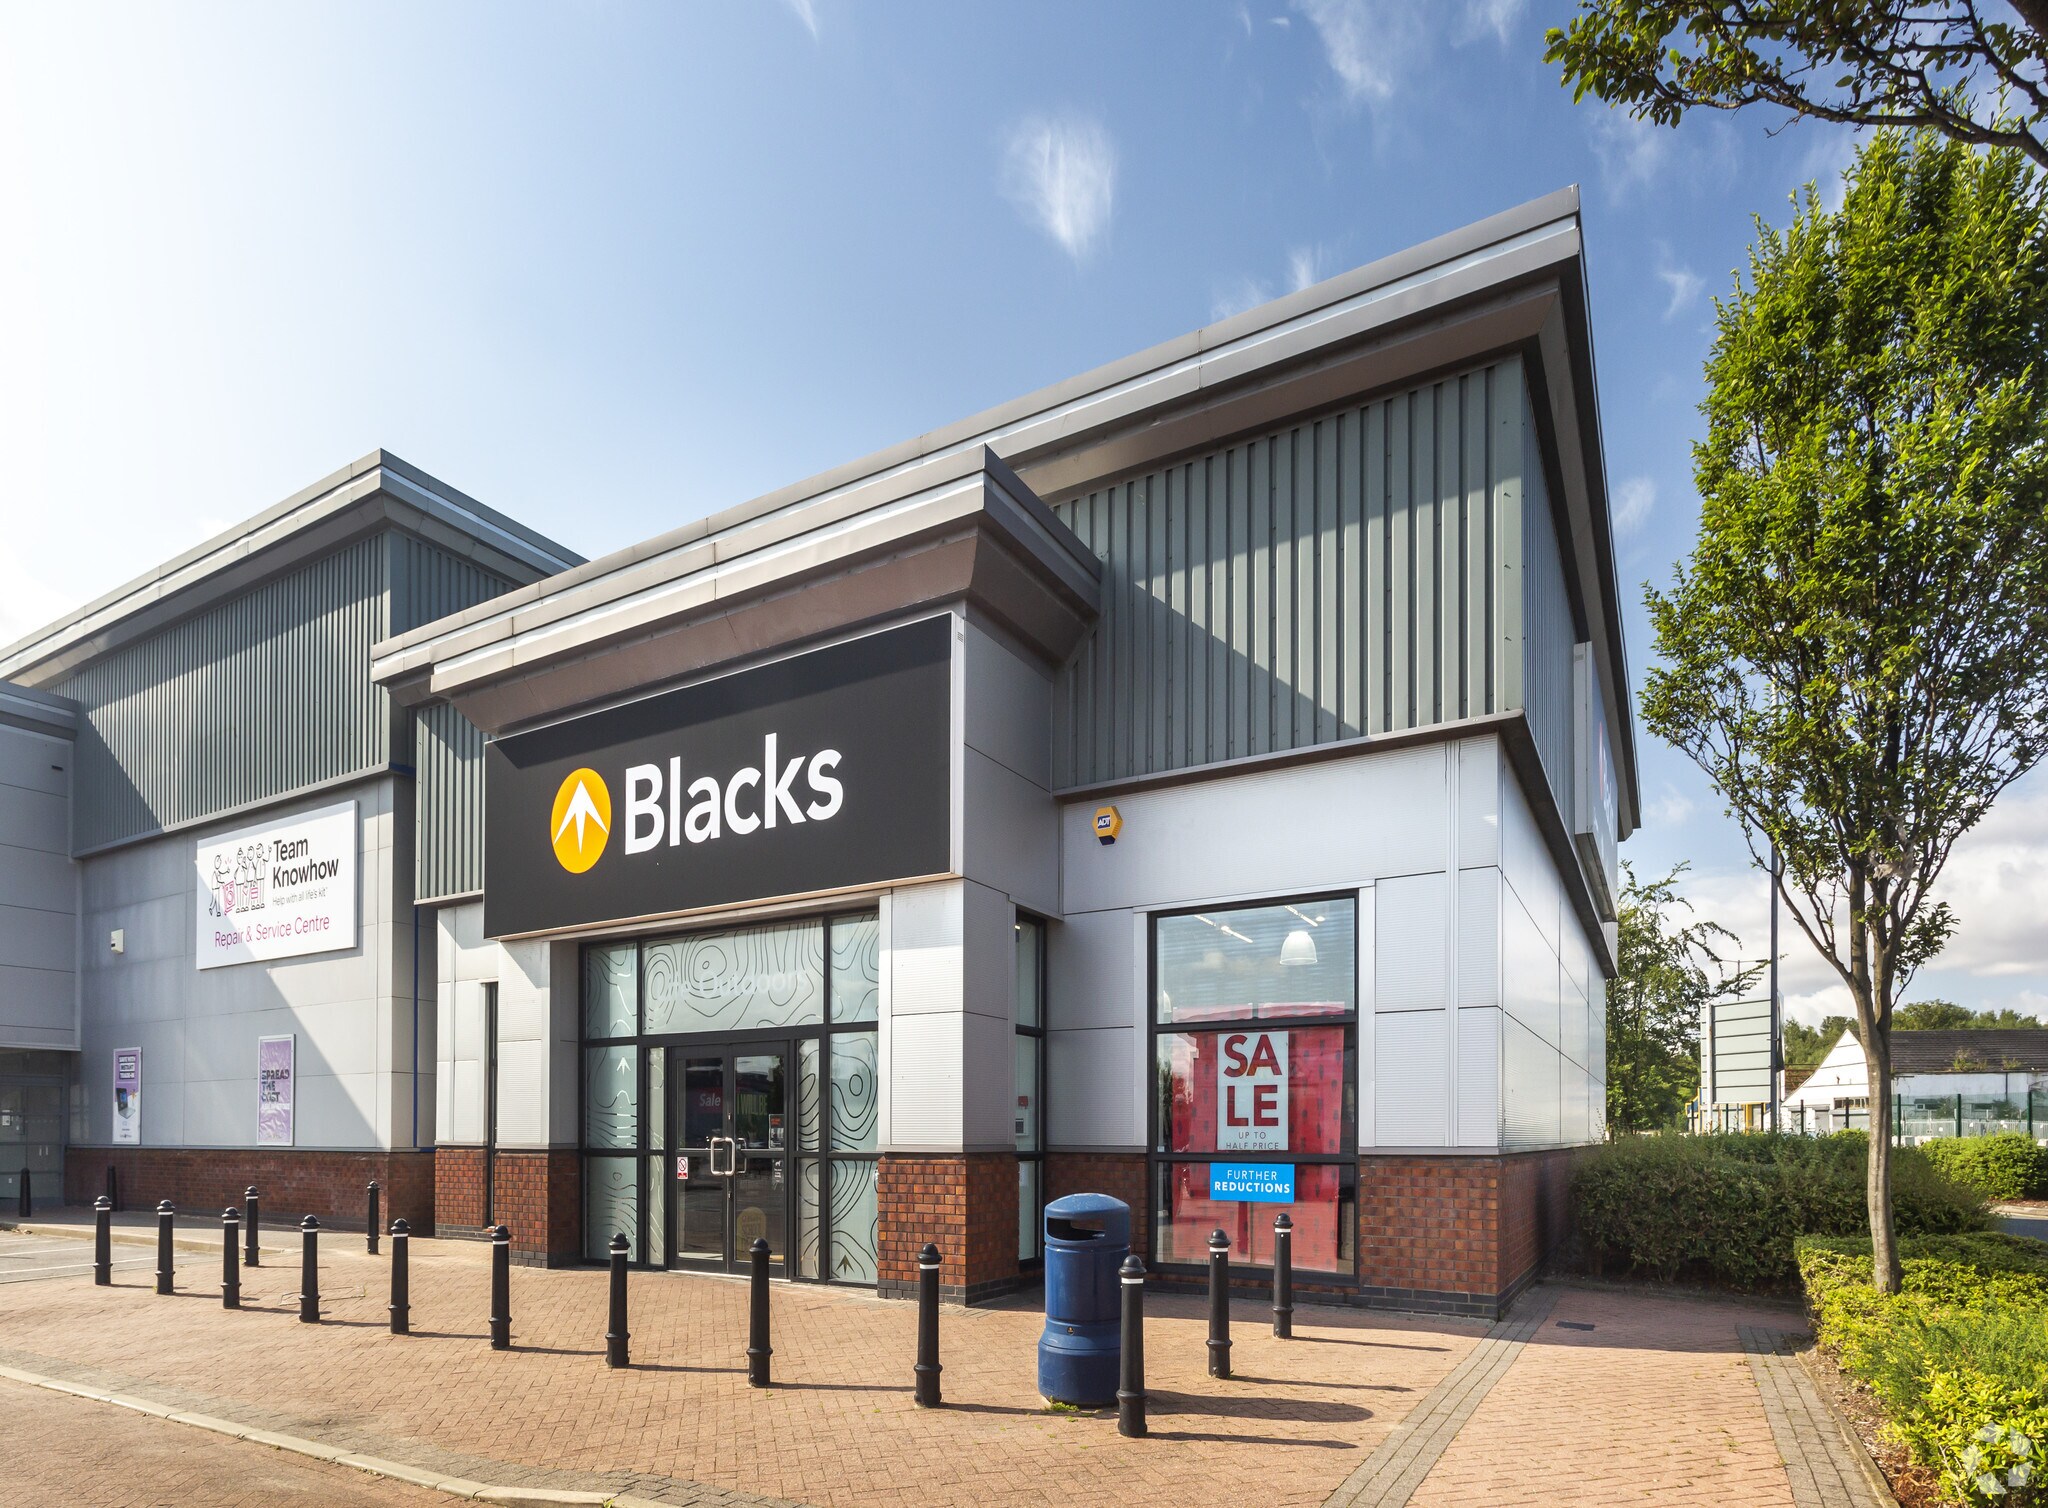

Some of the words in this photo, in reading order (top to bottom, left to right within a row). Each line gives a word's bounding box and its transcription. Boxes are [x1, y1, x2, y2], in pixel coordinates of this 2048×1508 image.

[625, 732, 844, 855] Blacks
[1098, 816, 1110, 827] ADT
[273, 838, 308, 862] Team
[272, 858, 339, 889] Knowhow
[272, 896, 285, 907] Help
[286, 893, 297, 904] with
[215, 927, 244, 950] Repair
[245, 925, 253, 942] &
[256, 921, 292, 941] Service
[295, 915, 330, 935] Centre
[261, 1069, 290, 1080] SPREAD
[261, 1081, 276, 1091] THE
[261, 1091, 280, 1103] COST
[700, 1093, 721, 1107] Sale
[1238, 1131, 1250, 1140] UP
[1254, 1131, 1267, 1140] TO
[1226, 1142, 1249, 1150] HALF
[1253, 1141, 1279, 1150] PRICE
[1226, 1169, 1277, 1181] FURTHER
[1214, 1181, 1290, 1194] REDUCTIONS
